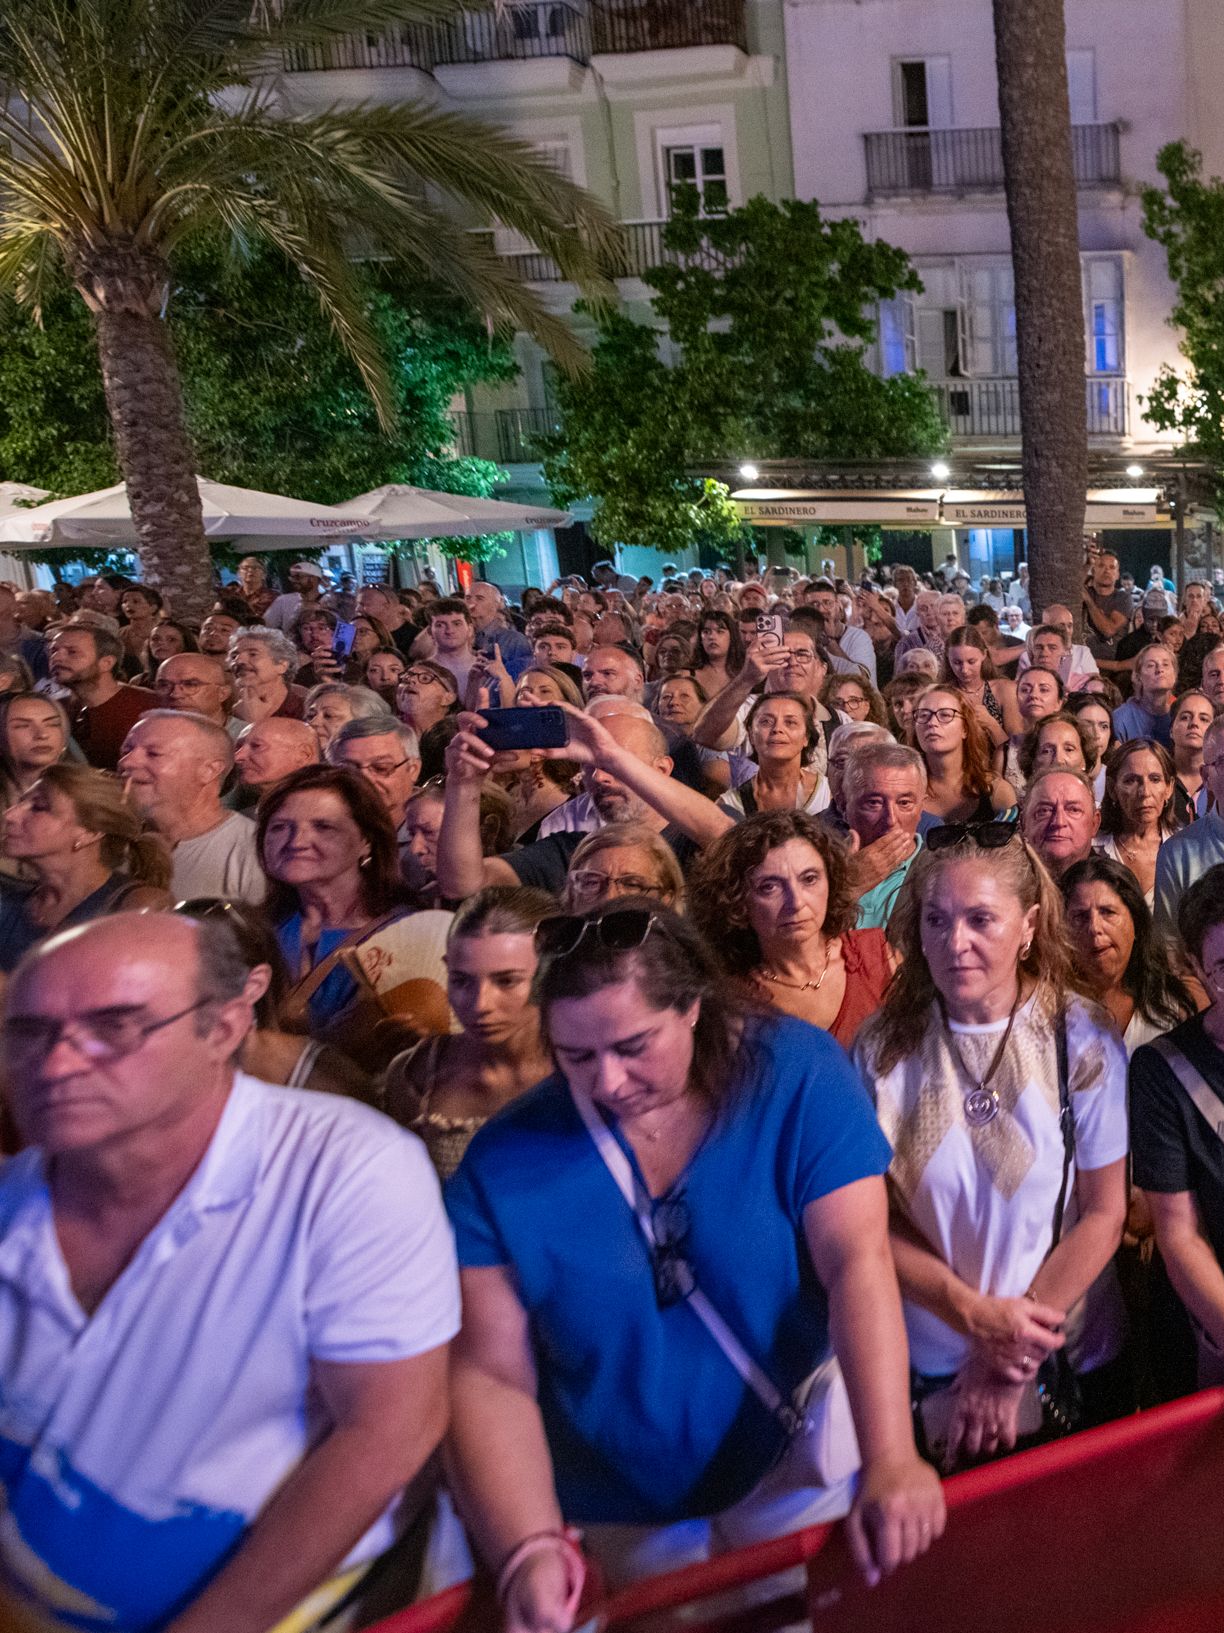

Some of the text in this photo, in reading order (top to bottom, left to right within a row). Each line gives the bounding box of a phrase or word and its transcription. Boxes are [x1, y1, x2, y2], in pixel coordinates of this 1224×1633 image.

[744, 506, 816, 515] EL SARDINERO
[955, 509, 967, 518] EL
[310, 518, 369, 528] Cruzcampo
